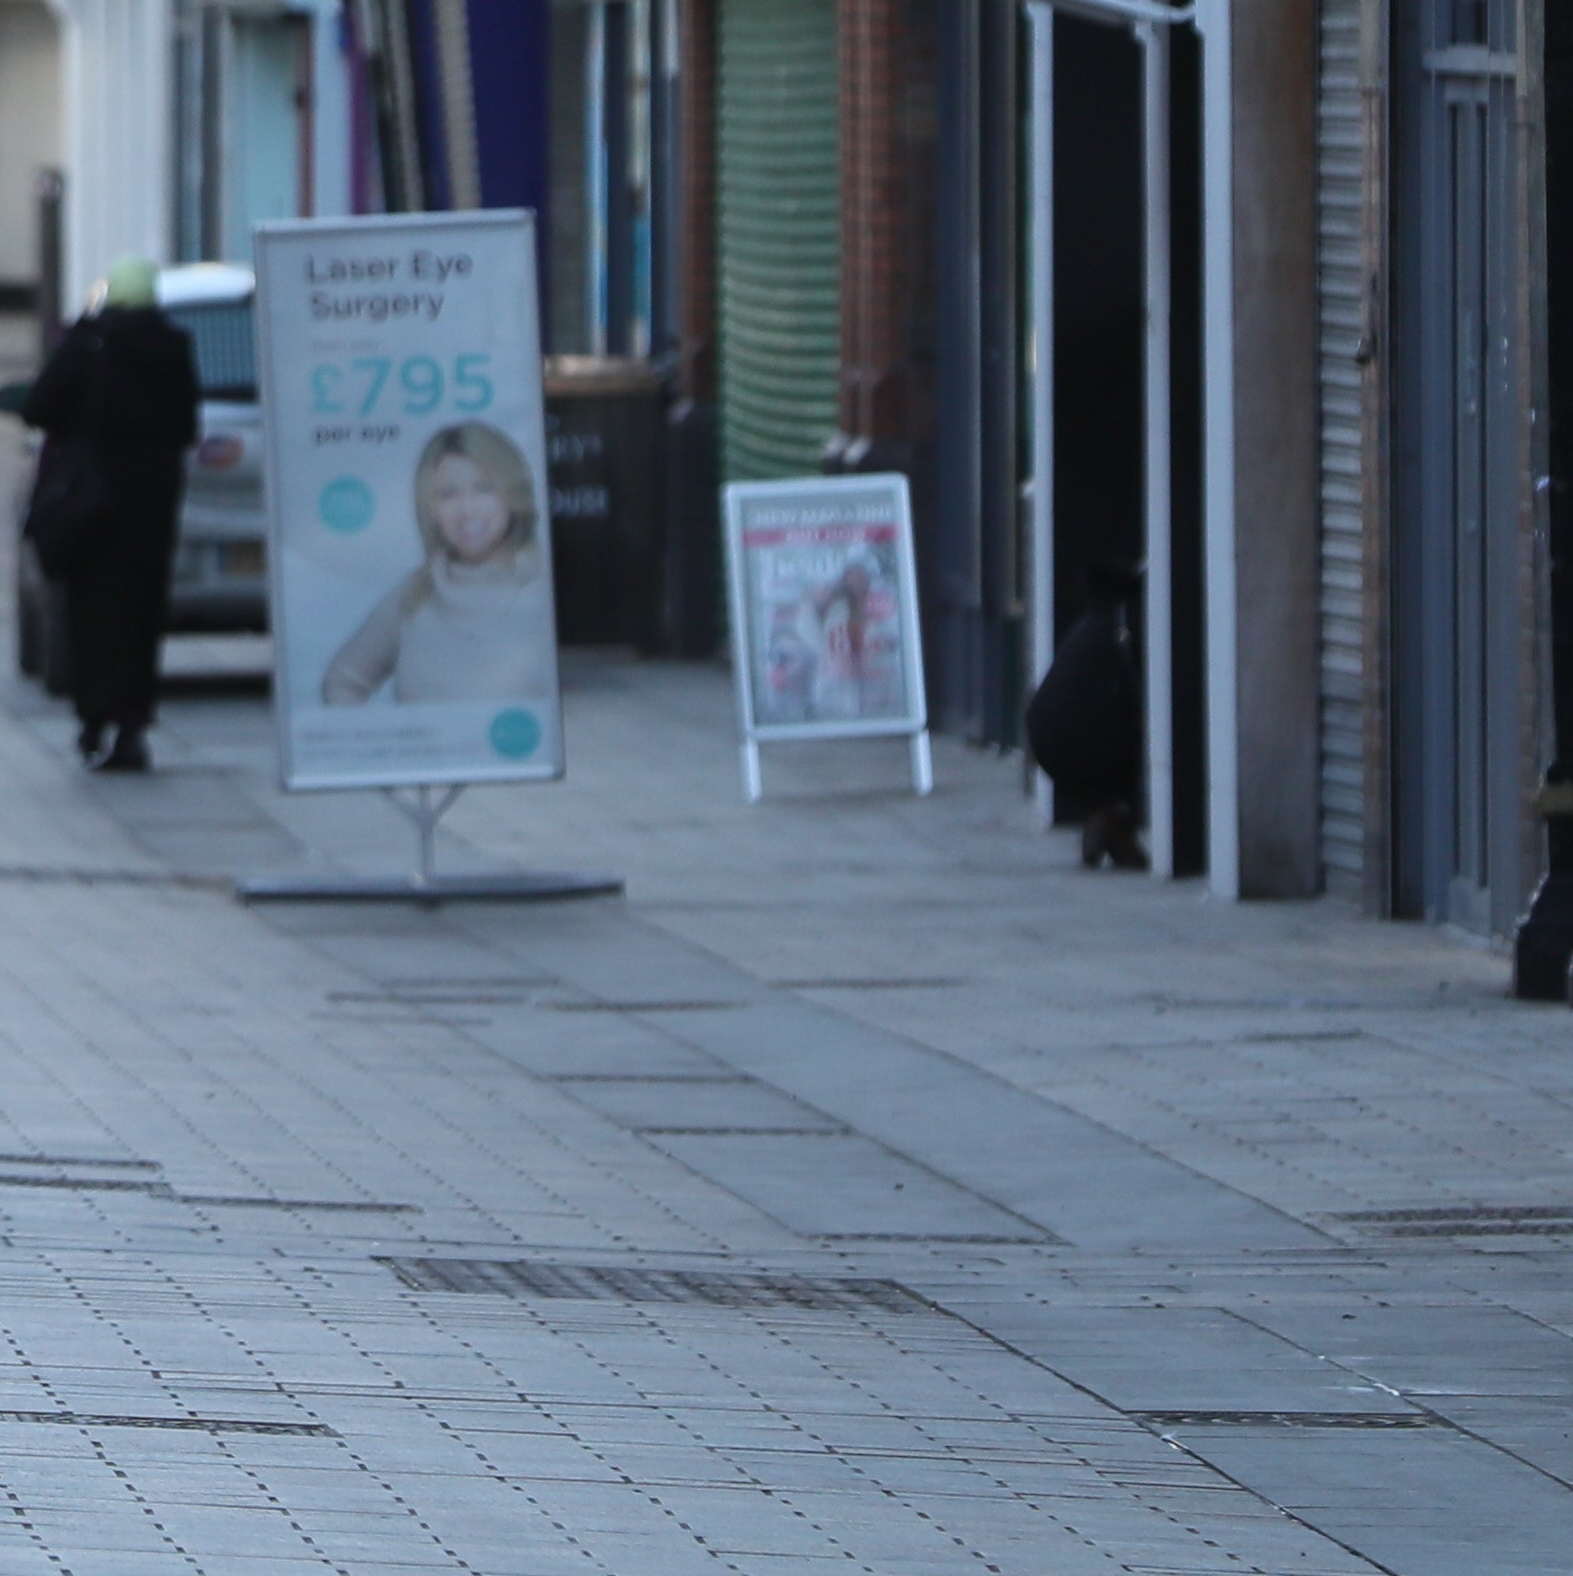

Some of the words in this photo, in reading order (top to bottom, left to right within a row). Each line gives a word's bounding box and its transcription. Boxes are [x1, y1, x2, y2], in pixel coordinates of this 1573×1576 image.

[308, 254, 398, 283] Laser
[412, 250, 474, 284] Eye
[309, 290, 445, 322] Surgery
[311, 352, 494, 416] £795
